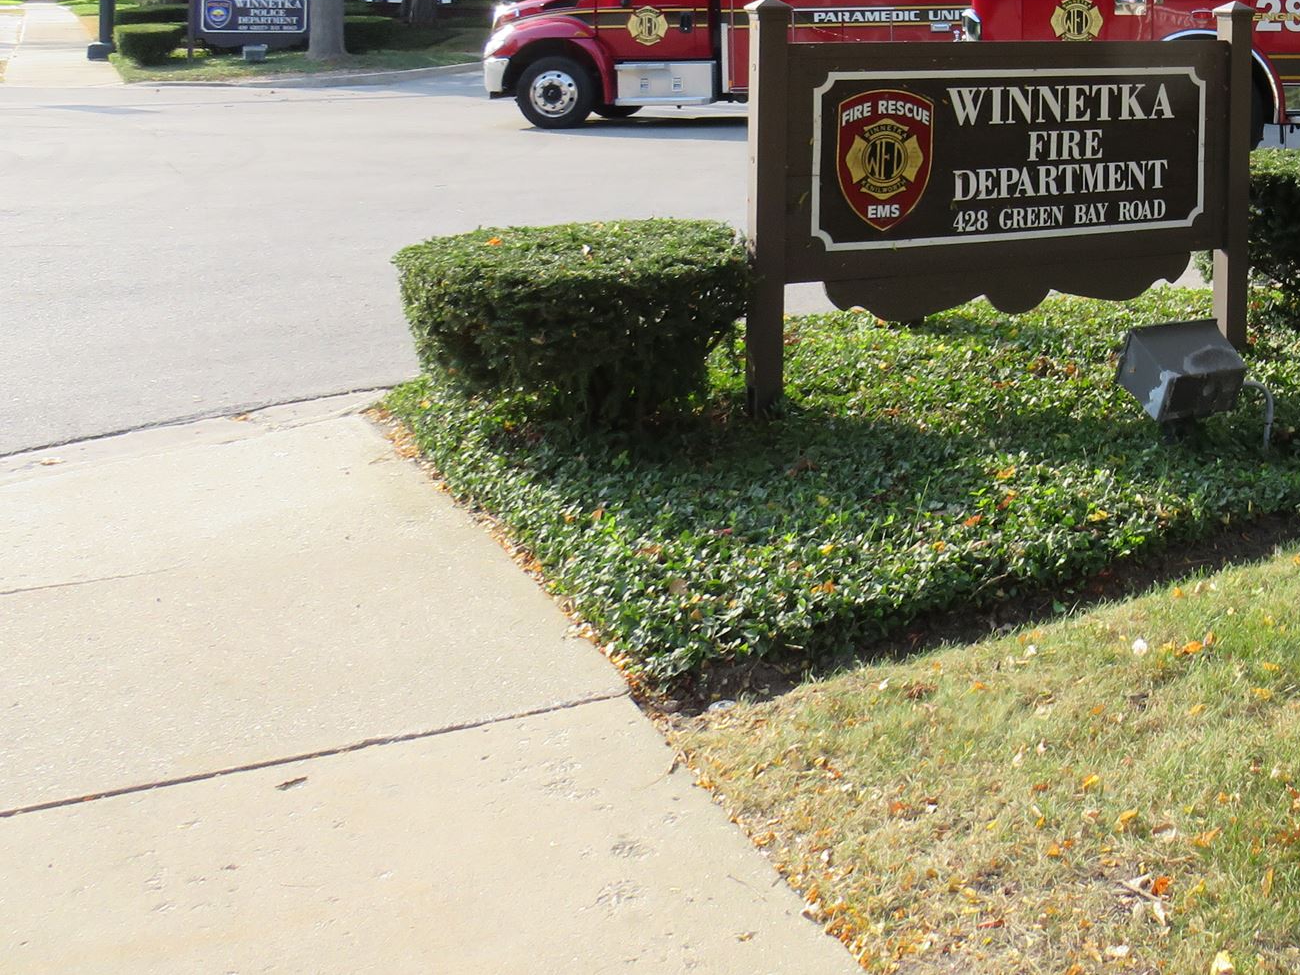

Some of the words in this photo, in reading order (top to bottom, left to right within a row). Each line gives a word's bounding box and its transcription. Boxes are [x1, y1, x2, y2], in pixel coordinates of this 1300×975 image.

[234, 0, 303, 8] WINNETKA
[238, 16, 299, 25] DEPARTMENT
[250, 8, 287, 17] POLICE
[813, 10, 921, 23] PARAMEDIC
[946, 82, 1175, 126] WINNETKA
[842, 102, 872, 126] FIRE
[878, 100, 930, 125] RESCUE
[864, 124, 908, 139] WINNETKA
[1027, 129, 1103, 161] FIRE
[867, 139, 905, 180] WFD
[861, 177, 908, 193] KENILWORTH
[953, 159, 1168, 202] DEPARTMENT
[867, 204, 900, 218] EMS
[953, 209, 988, 232] 428
[999, 205, 1064, 229] GREEN
[1074, 202, 1109, 225] BAY
[1119, 199, 1166, 222] ROAD
